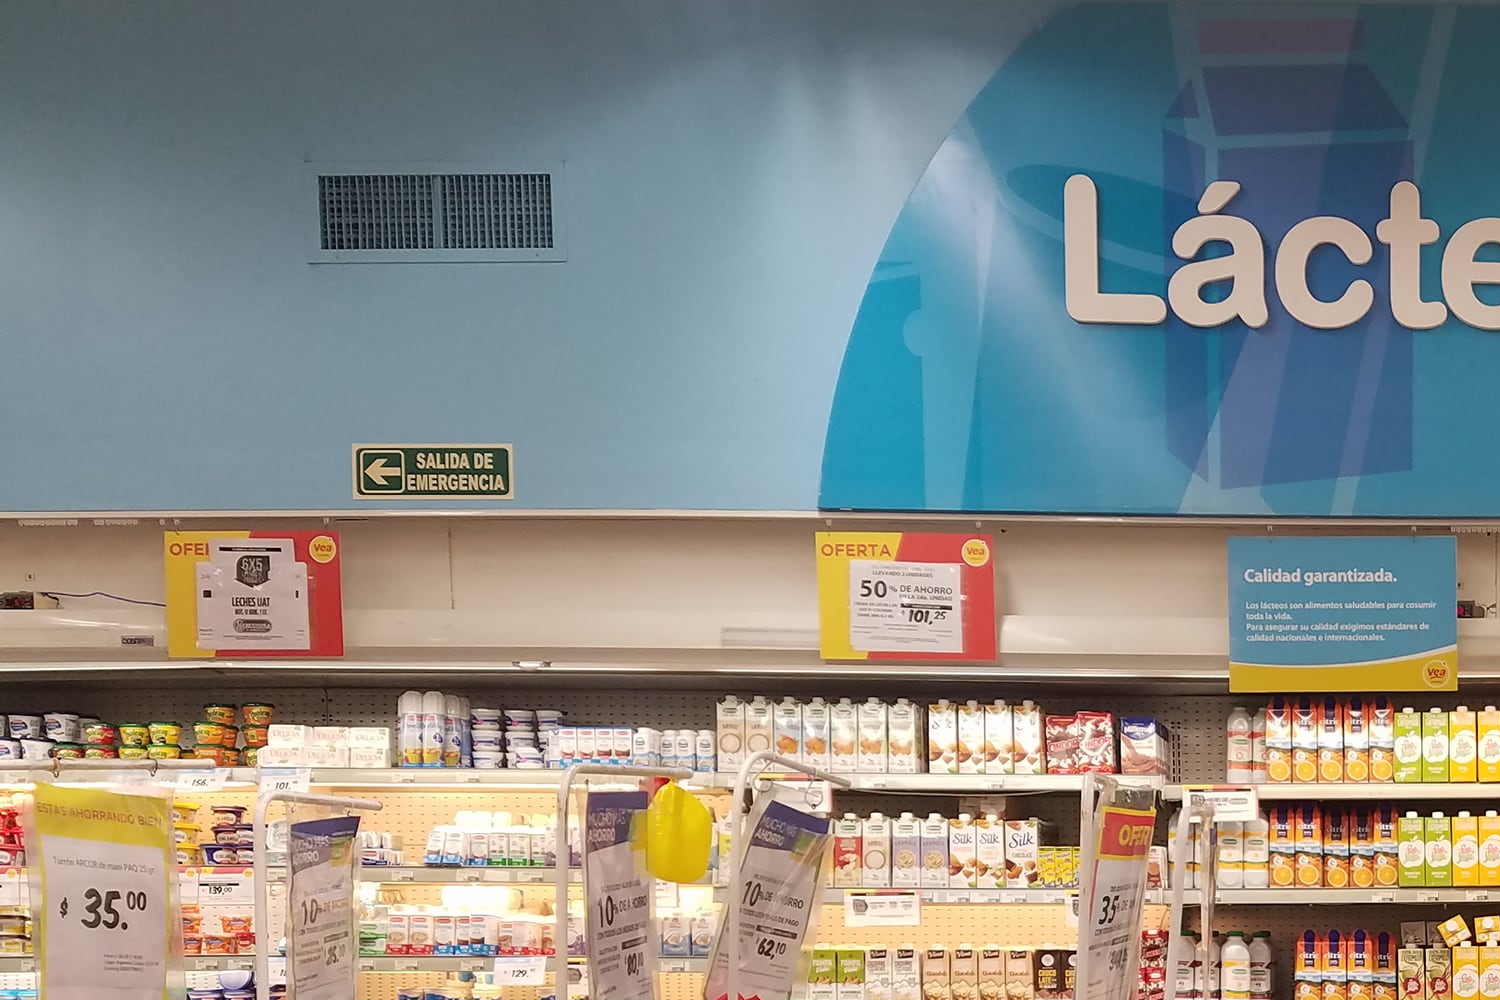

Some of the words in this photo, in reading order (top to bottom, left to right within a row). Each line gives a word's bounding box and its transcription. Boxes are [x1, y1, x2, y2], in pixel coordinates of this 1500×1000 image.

[416, 452, 470, 470] SALIDA
[473, 453, 494, 469] DE
[406, 474, 506, 491] EMERGENCIA
[314, 543, 333, 553] Vea
[821, 543, 892, 557] OFERTA
[966, 547, 985, 556] Vea
[1243, 568, 1301, 583] Calidad
[1303, 568, 1398, 586] garantizada.
[859, 579, 888, 599] 50
[900, 585, 912, 594] DE
[913, 585, 953, 595] AHORRO
[231, 597, 256, 607] LECHES
[1260, 601, 1288, 609] lácteos
[1304, 601, 1343, 609] alimentos
[1344, 601, 1386, 609] saludables
[1386, 602, 1405, 611] para
[1245, 612, 1264, 620] toda
[1265, 612, 1273, 620] la
[1273, 612, 1293, 620] vida.
[1245, 623, 1263, 631] Para
[1264, 624, 1299, 633] asegurar
[1310, 622, 1339, 631] calidad
[1340, 623, 1374, 632] exigimos
[1375, 622, 1418, 631] estándares
[1246, 633, 1275, 642] calidad
[1275, 633, 1317, 642] nacionales
[1324, 633, 1386, 642] internacionales.
[1427, 667, 1447, 680] Vea
[952, 832, 974, 845] Silk
[979, 832, 1000, 845] Silk
[1008, 832, 1035, 849] Silk
[208, 885, 232, 896] 139,00
[59, 896, 69, 918] $
[1099, 896, 1117, 927] 35
